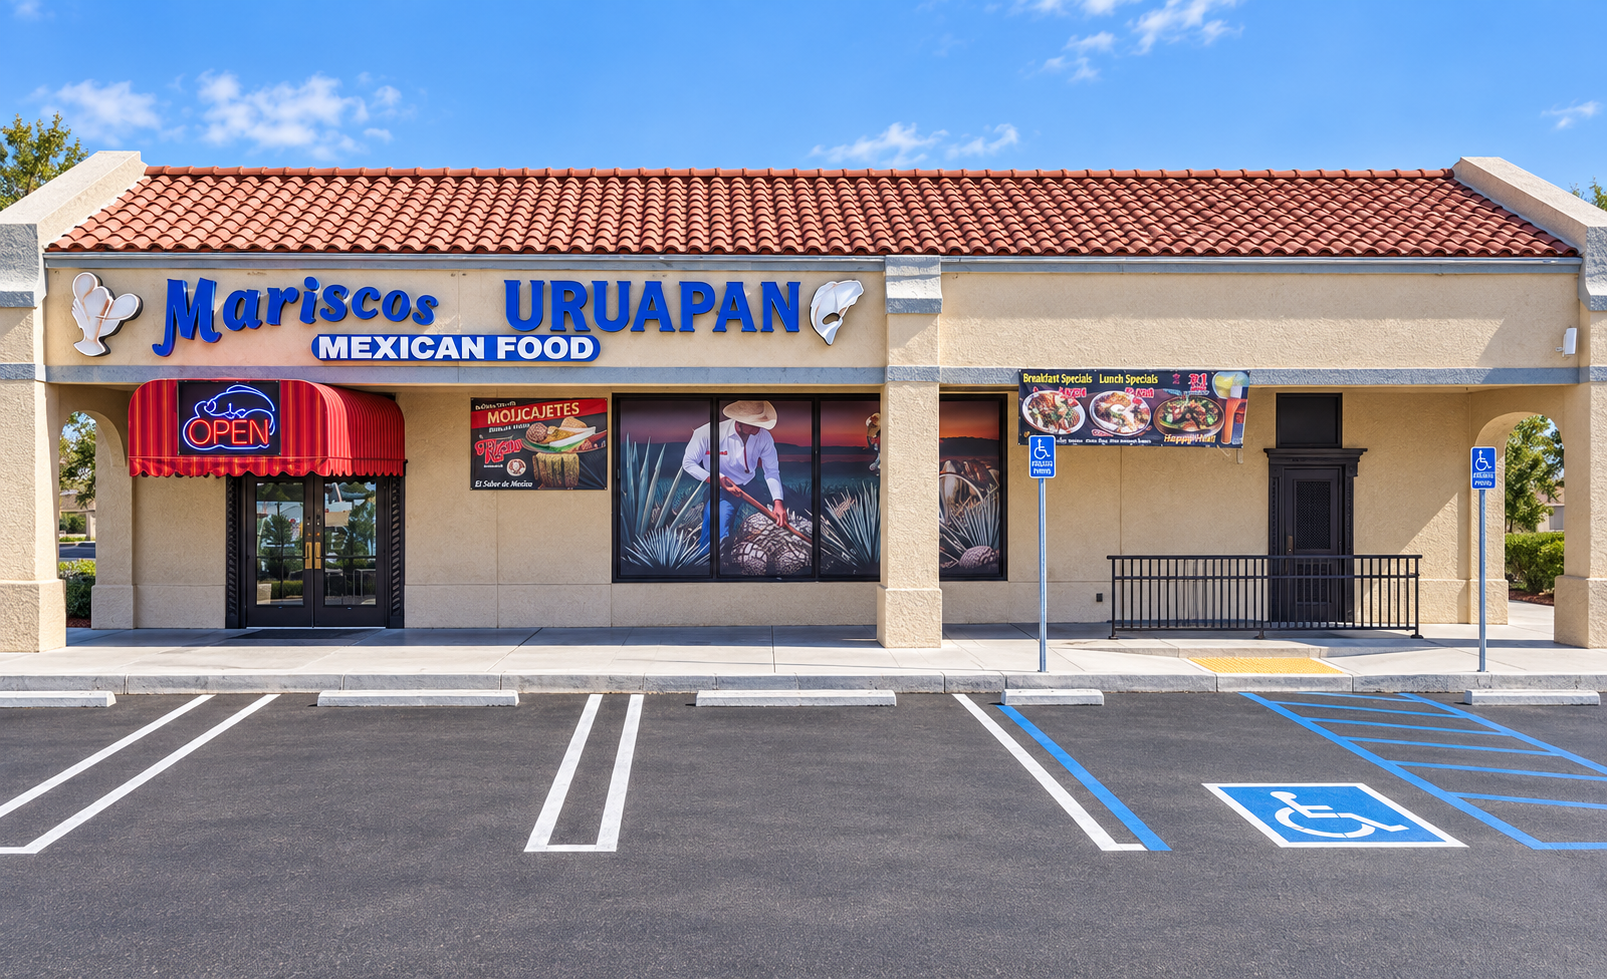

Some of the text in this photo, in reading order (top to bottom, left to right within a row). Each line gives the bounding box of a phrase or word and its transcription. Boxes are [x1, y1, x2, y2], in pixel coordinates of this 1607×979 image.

[152, 276, 439, 357] Mariscos
[504, 279, 801, 333] URUAPAN
[318, 336, 594, 359] MEXICAN FOOD
[1023, 373, 1093, 385] Breakfast Specials
[1099, 373, 1159, 385] Lunch Specials
[188, 419, 269, 445] OPEN
